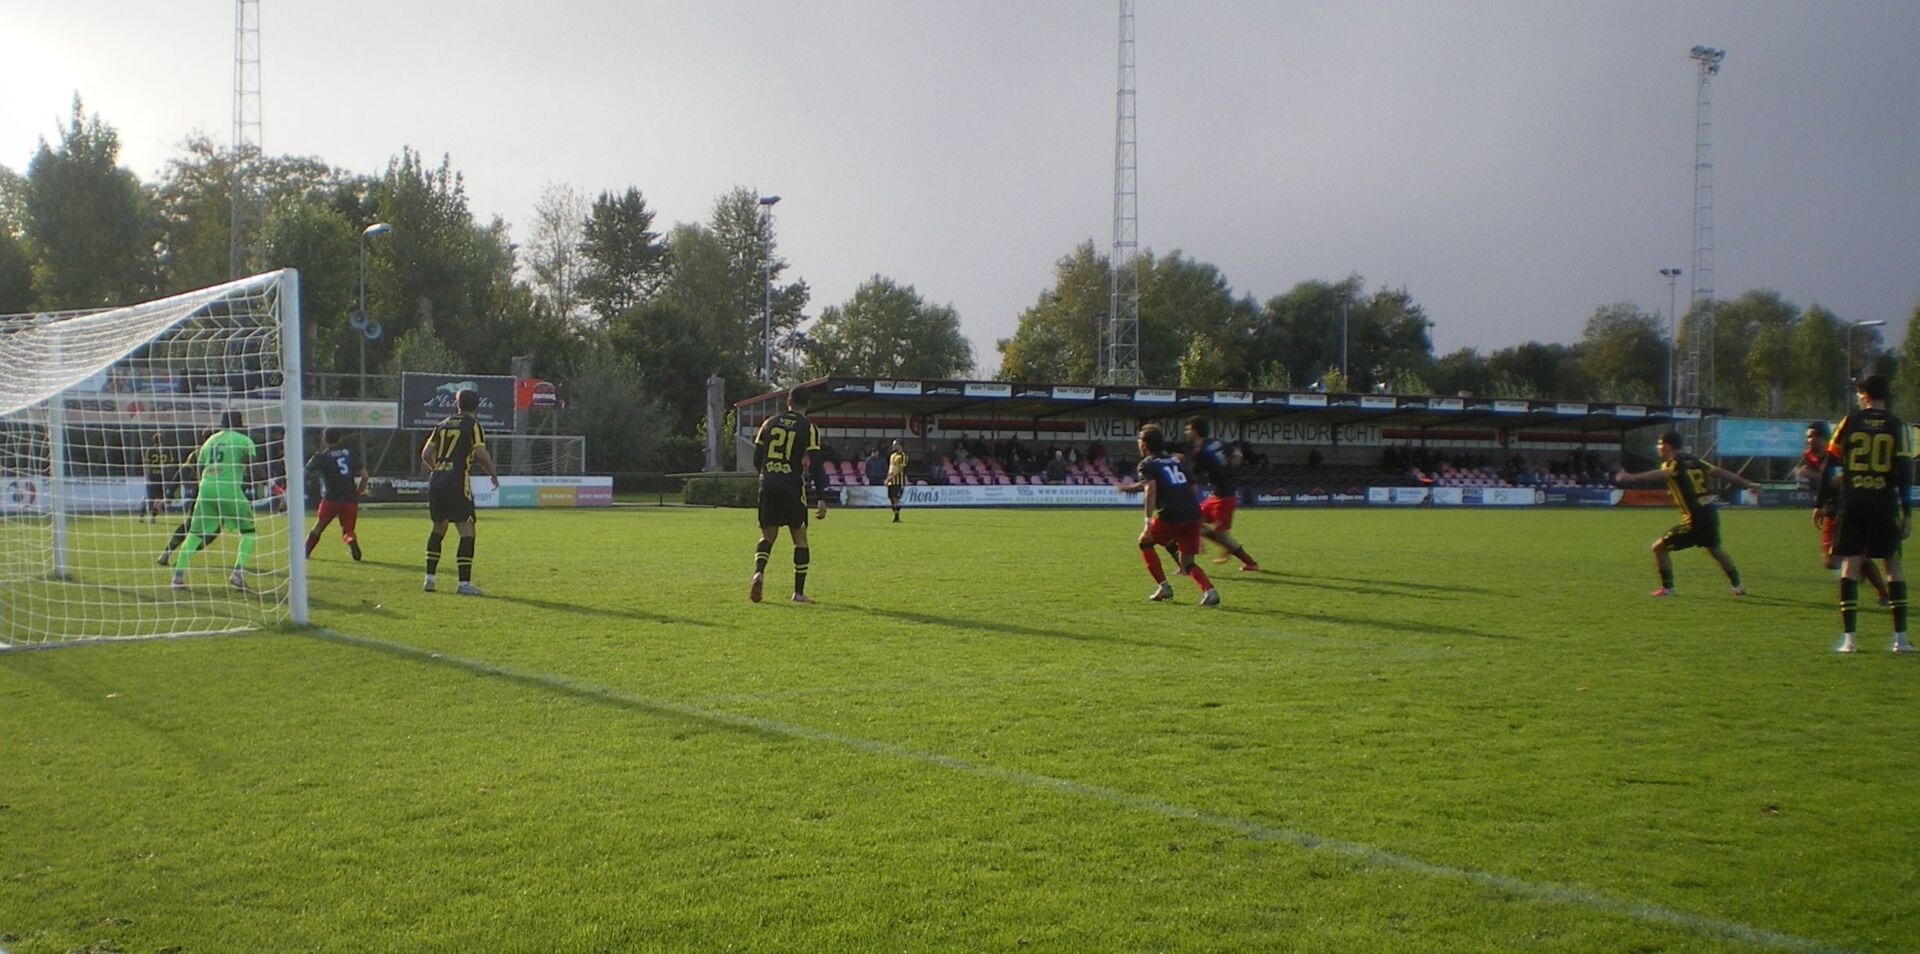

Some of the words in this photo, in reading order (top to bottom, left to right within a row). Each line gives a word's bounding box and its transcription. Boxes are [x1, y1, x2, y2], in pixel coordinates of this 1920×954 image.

[1092, 418, 1179, 438] WELM
[1248, 421, 1377, 443] PAPENDRECHT
[436, 428, 461, 459] 17
[767, 427, 796, 461] 21
[1849, 431, 1895, 473] 20
[336, 456, 349, 475] 5
[1163, 464, 1188, 485] 16
[907, 487, 939, 502] Ron's
